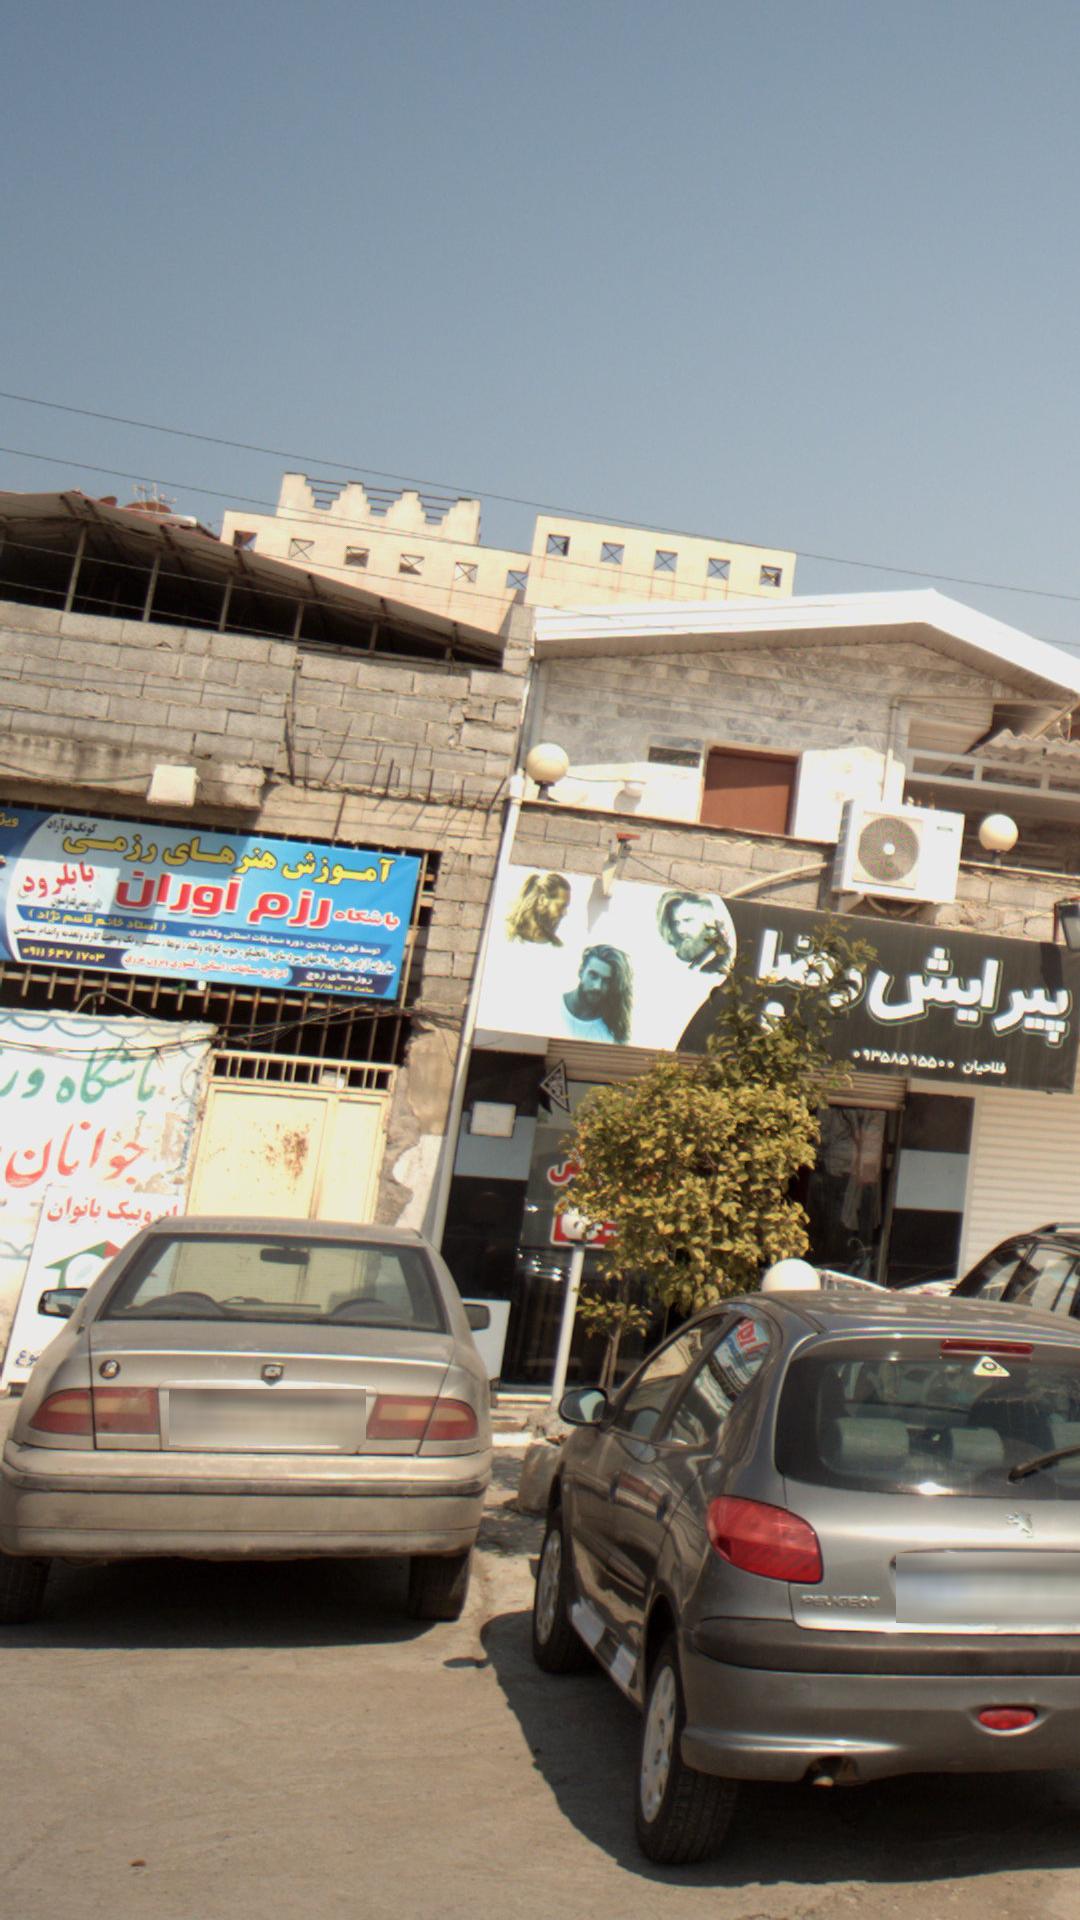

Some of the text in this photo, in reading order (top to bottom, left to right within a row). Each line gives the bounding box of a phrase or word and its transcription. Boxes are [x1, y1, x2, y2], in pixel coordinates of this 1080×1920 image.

[62, 834, 396, 886] آموزش هنر های رزمی
[115, 869, 400, 931] باشگاه رزم آوران
[62, 912, 93, 925] قاسم
[305, 970, 373, 985] روزهای زوج
[868, 946, 1070, 1043] پیرایش
[56, 1038, 156, 1104] باشگاه
[961, 1059, 1008, 1076] فلاحیان
[46, 1196, 102, 1224] بانوان
[800, 1594, 881, 1608] PEUGEOT
